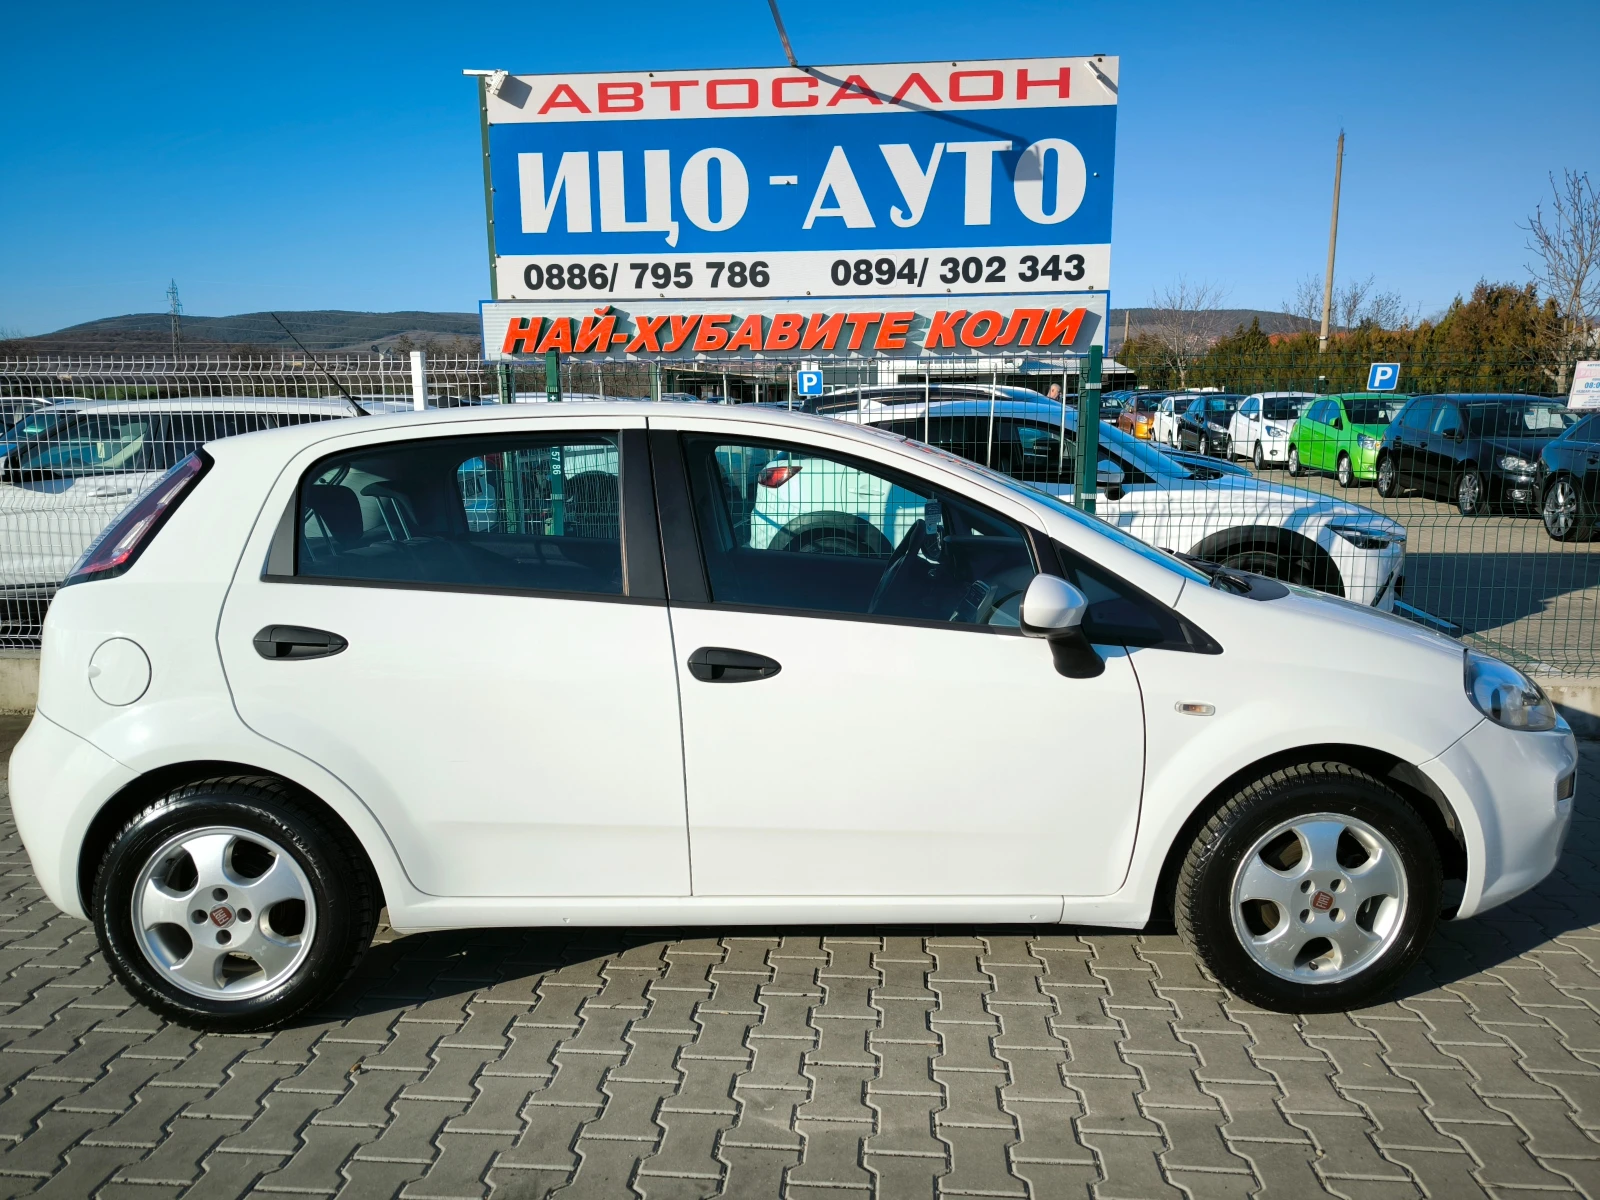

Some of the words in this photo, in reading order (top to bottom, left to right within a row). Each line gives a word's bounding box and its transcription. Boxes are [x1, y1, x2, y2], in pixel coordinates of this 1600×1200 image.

[538, 66, 1072, 115] АВТОСАЛОН
[523, 262, 619, 292] 0886/
[629, 262, 693, 290] 795
[705, 260, 770, 288] 786
[830, 257, 930, 288] 0894/
[939, 255, 1007, 284] 302
[1018, 253, 1085, 283] 343
[501, 305, 915, 355] НАЙ-ХУБАВИТЕ
[924, 307, 1087, 349] КОЛИ
[802, 373, 818, 393] P
[1373, 366, 1393, 387] P
[1315, 893, 1330, 909] FIAT
[212, 908, 230, 925] FIAT
